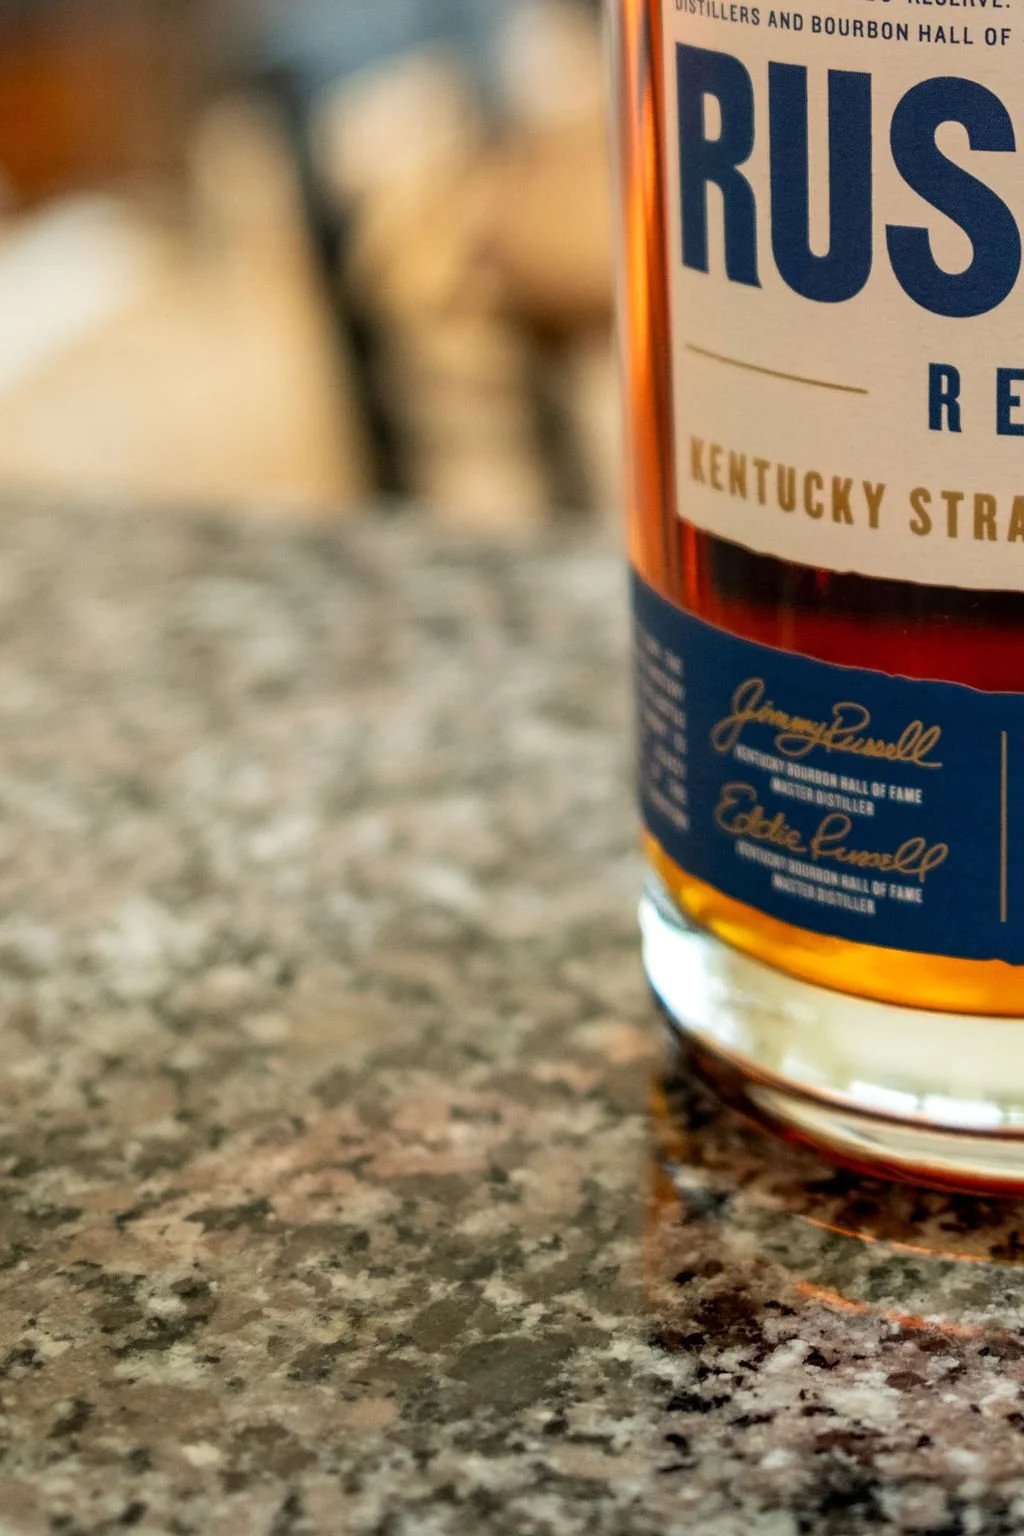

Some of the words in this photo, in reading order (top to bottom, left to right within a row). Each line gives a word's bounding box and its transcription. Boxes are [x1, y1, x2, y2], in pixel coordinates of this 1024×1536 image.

[768, 10, 803, 31] AND
[811, 15, 909, 41] BOURBON
[918, 24, 973, 44] HALL
[985, 27, 1011, 46] OF
[689, 435, 887, 531] KENTUCKY
[771, 776, 814, 803] MASTER
[815, 789, 874, 816] DISTILLER
[787, 762, 837, 788] BOURBON
[840, 775, 869, 797] HALL
[871, 782, 887, 798] OF
[888, 785, 923, 804] FAME
[714, 782, 808, 853] Eddie
[788, 859, 838, 885] BOURBON
[841, 873, 870, 894] HALL
[871, 880, 887, 897] OF
[888, 884, 923, 903] FAME
[816, 887, 876, 914] DISTILLER
